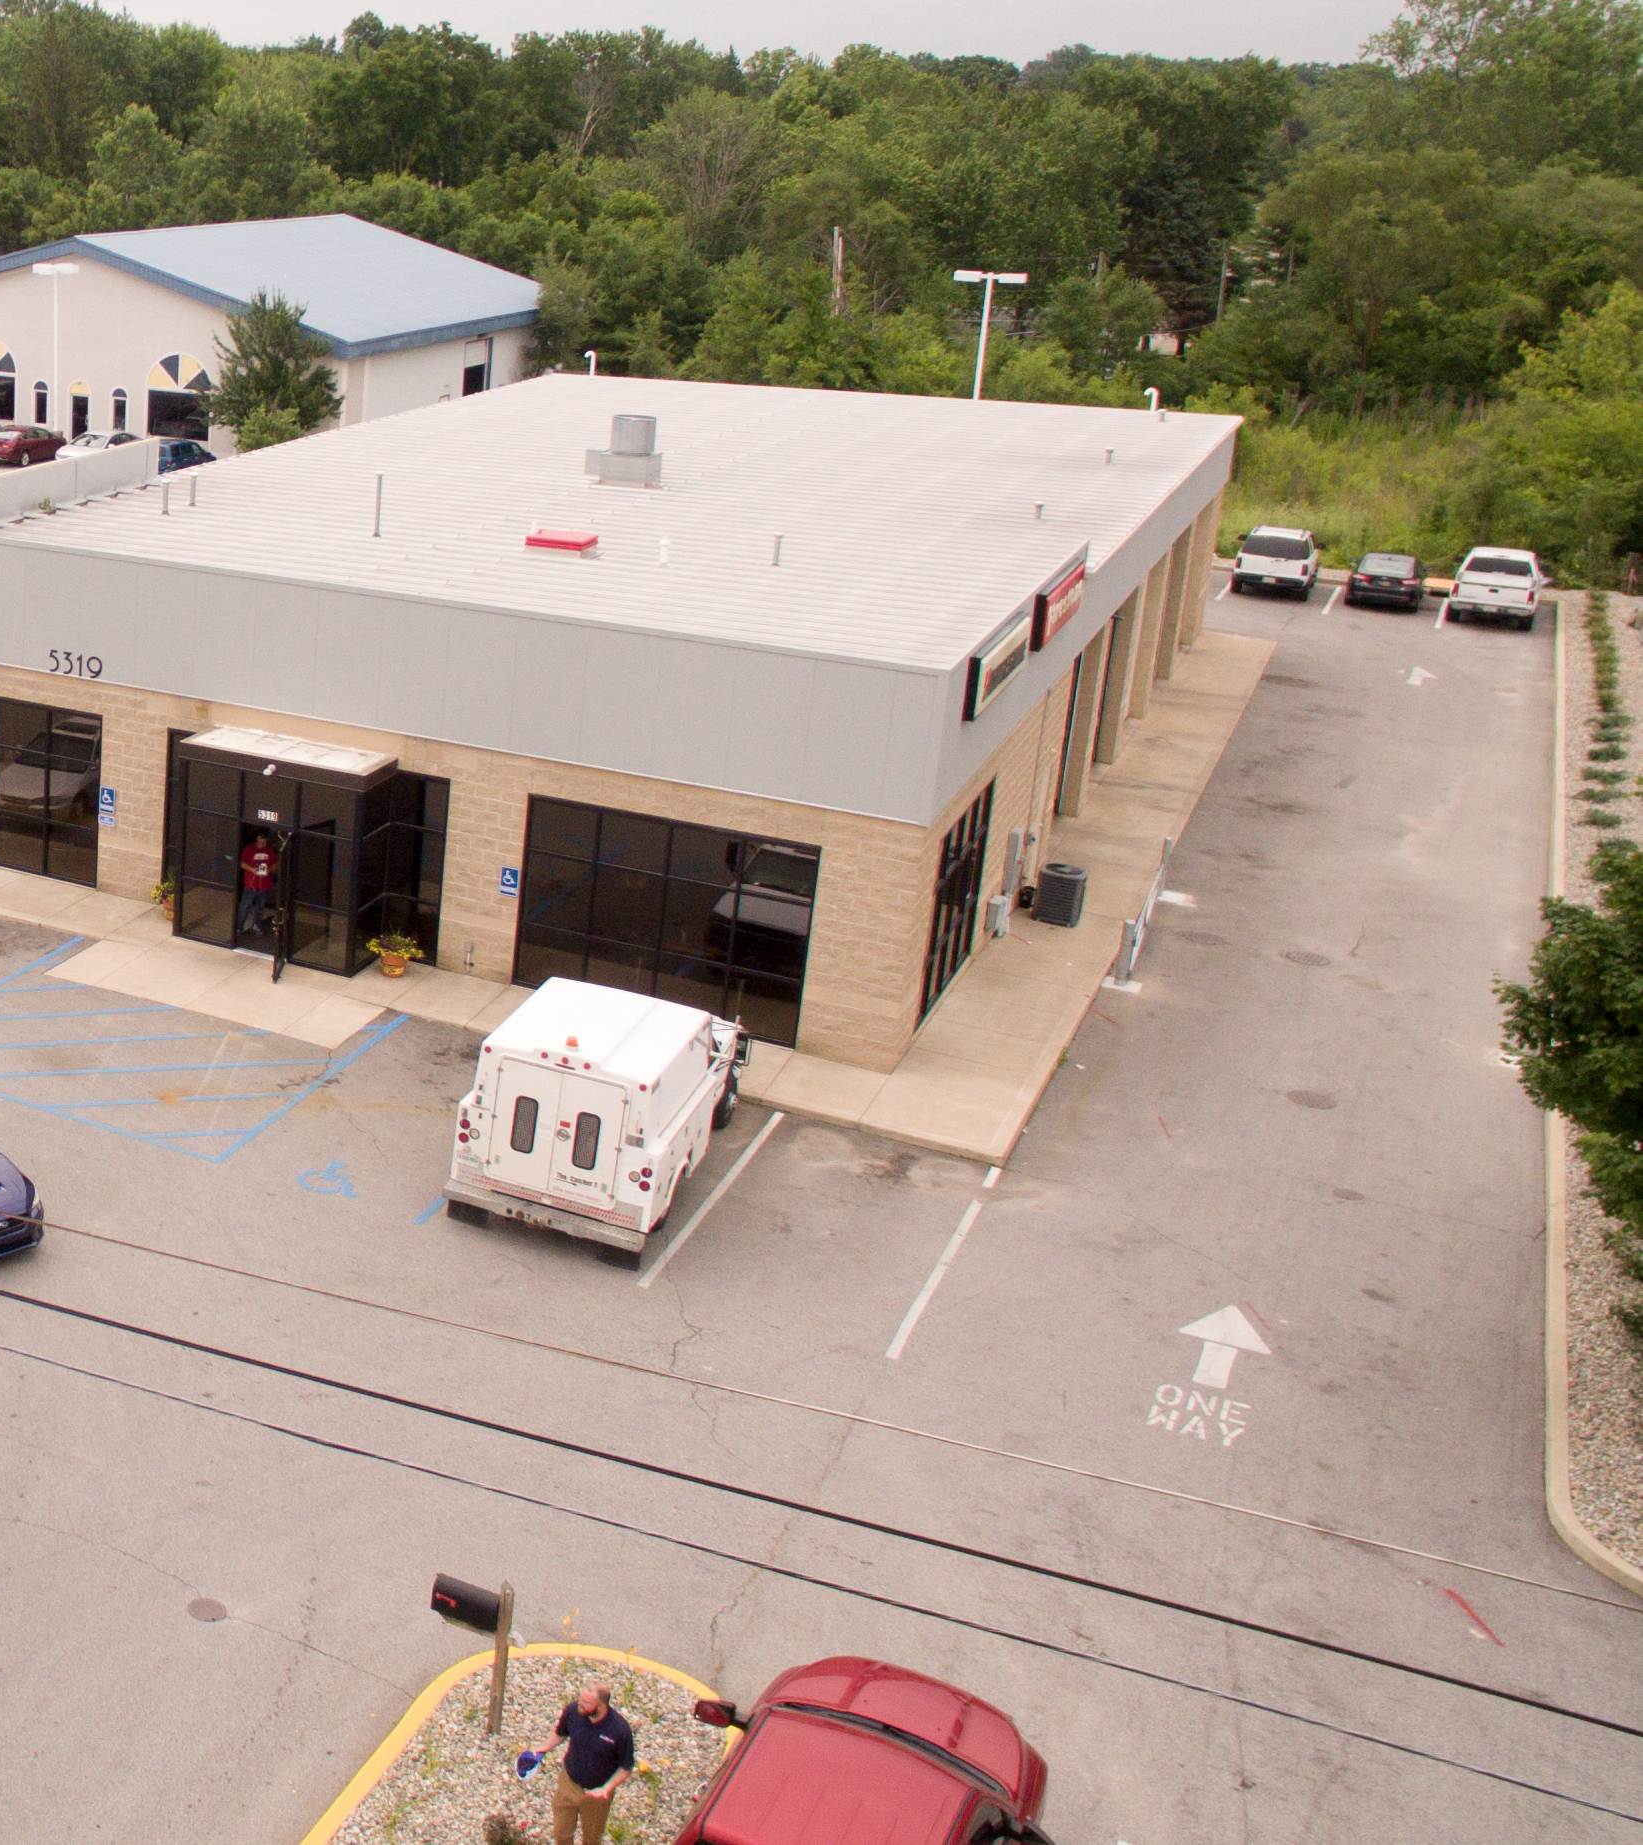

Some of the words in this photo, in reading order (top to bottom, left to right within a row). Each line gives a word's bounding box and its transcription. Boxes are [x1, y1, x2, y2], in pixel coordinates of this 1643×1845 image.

[49, 649, 103, 679] 5319
[1146, 1404, 1245, 1447] WAY
[1155, 1383, 1251, 1426] ONE
